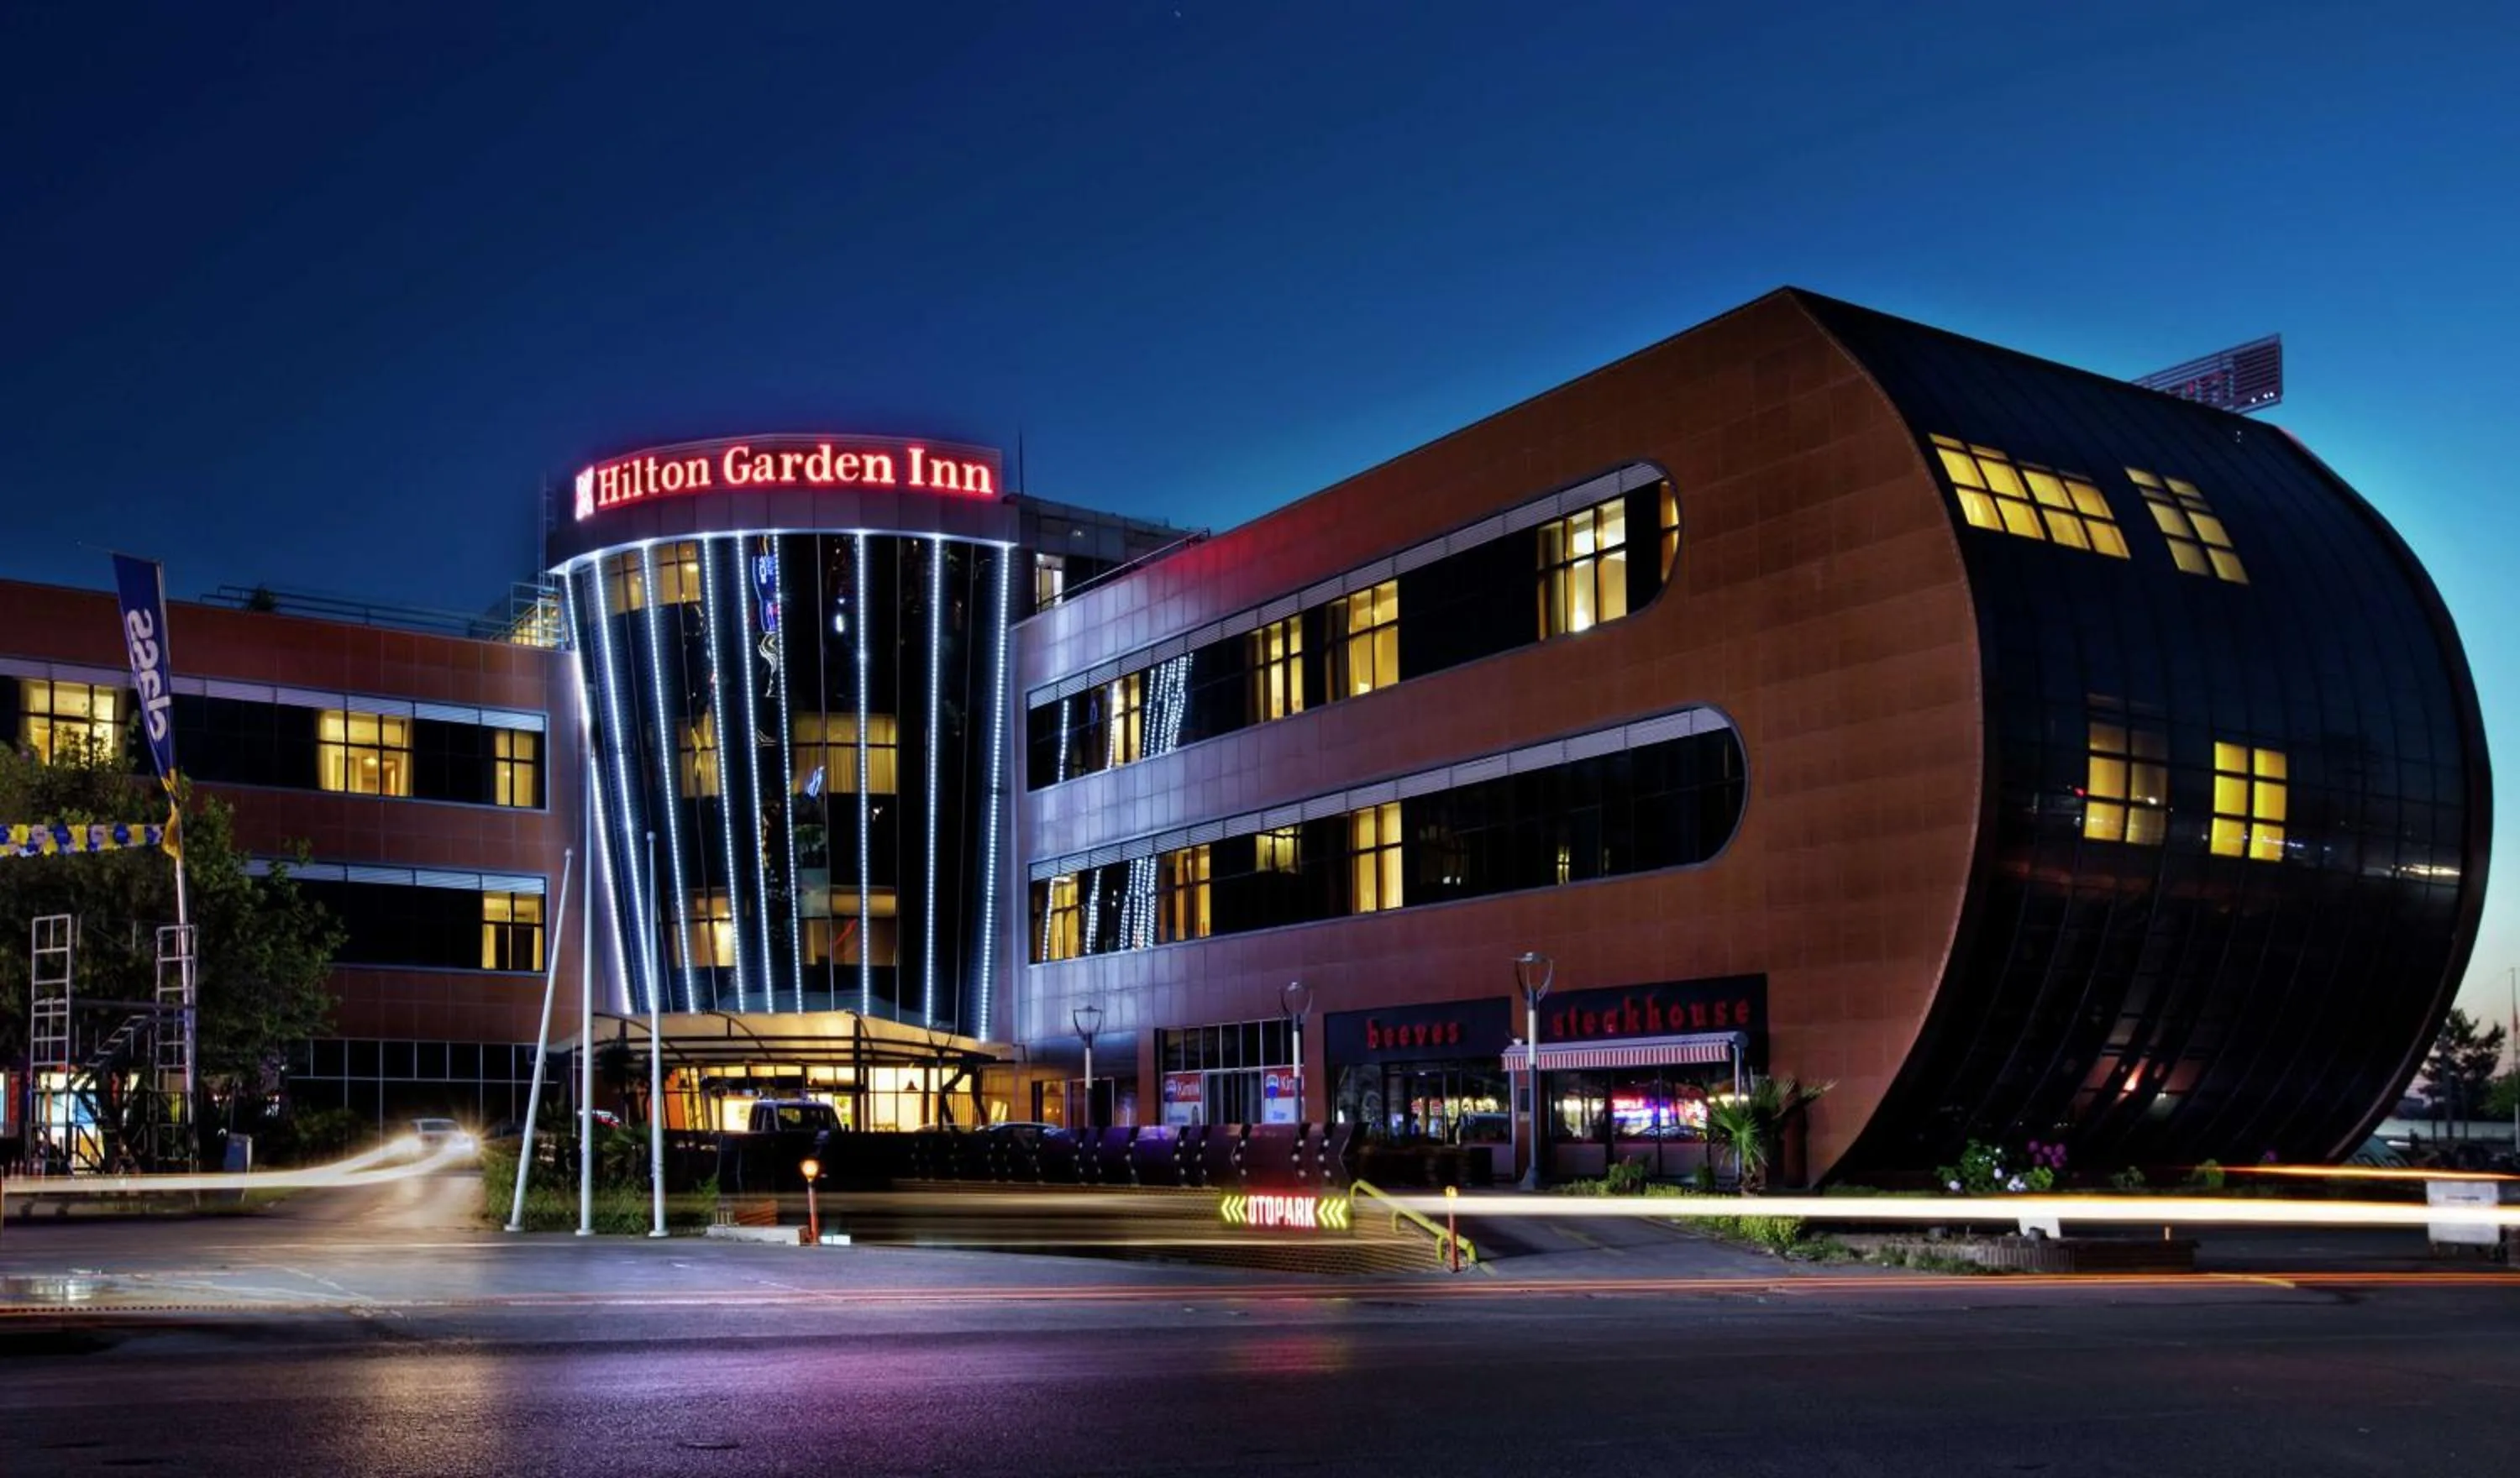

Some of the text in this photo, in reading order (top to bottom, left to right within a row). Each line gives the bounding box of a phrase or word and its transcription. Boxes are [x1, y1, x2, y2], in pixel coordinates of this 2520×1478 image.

[597, 444, 993, 506] Hilton Garden Inn
[1366, 994, 1751, 1051] beeves steakhouse
[1247, 1195, 1316, 1227] OTOPARK
